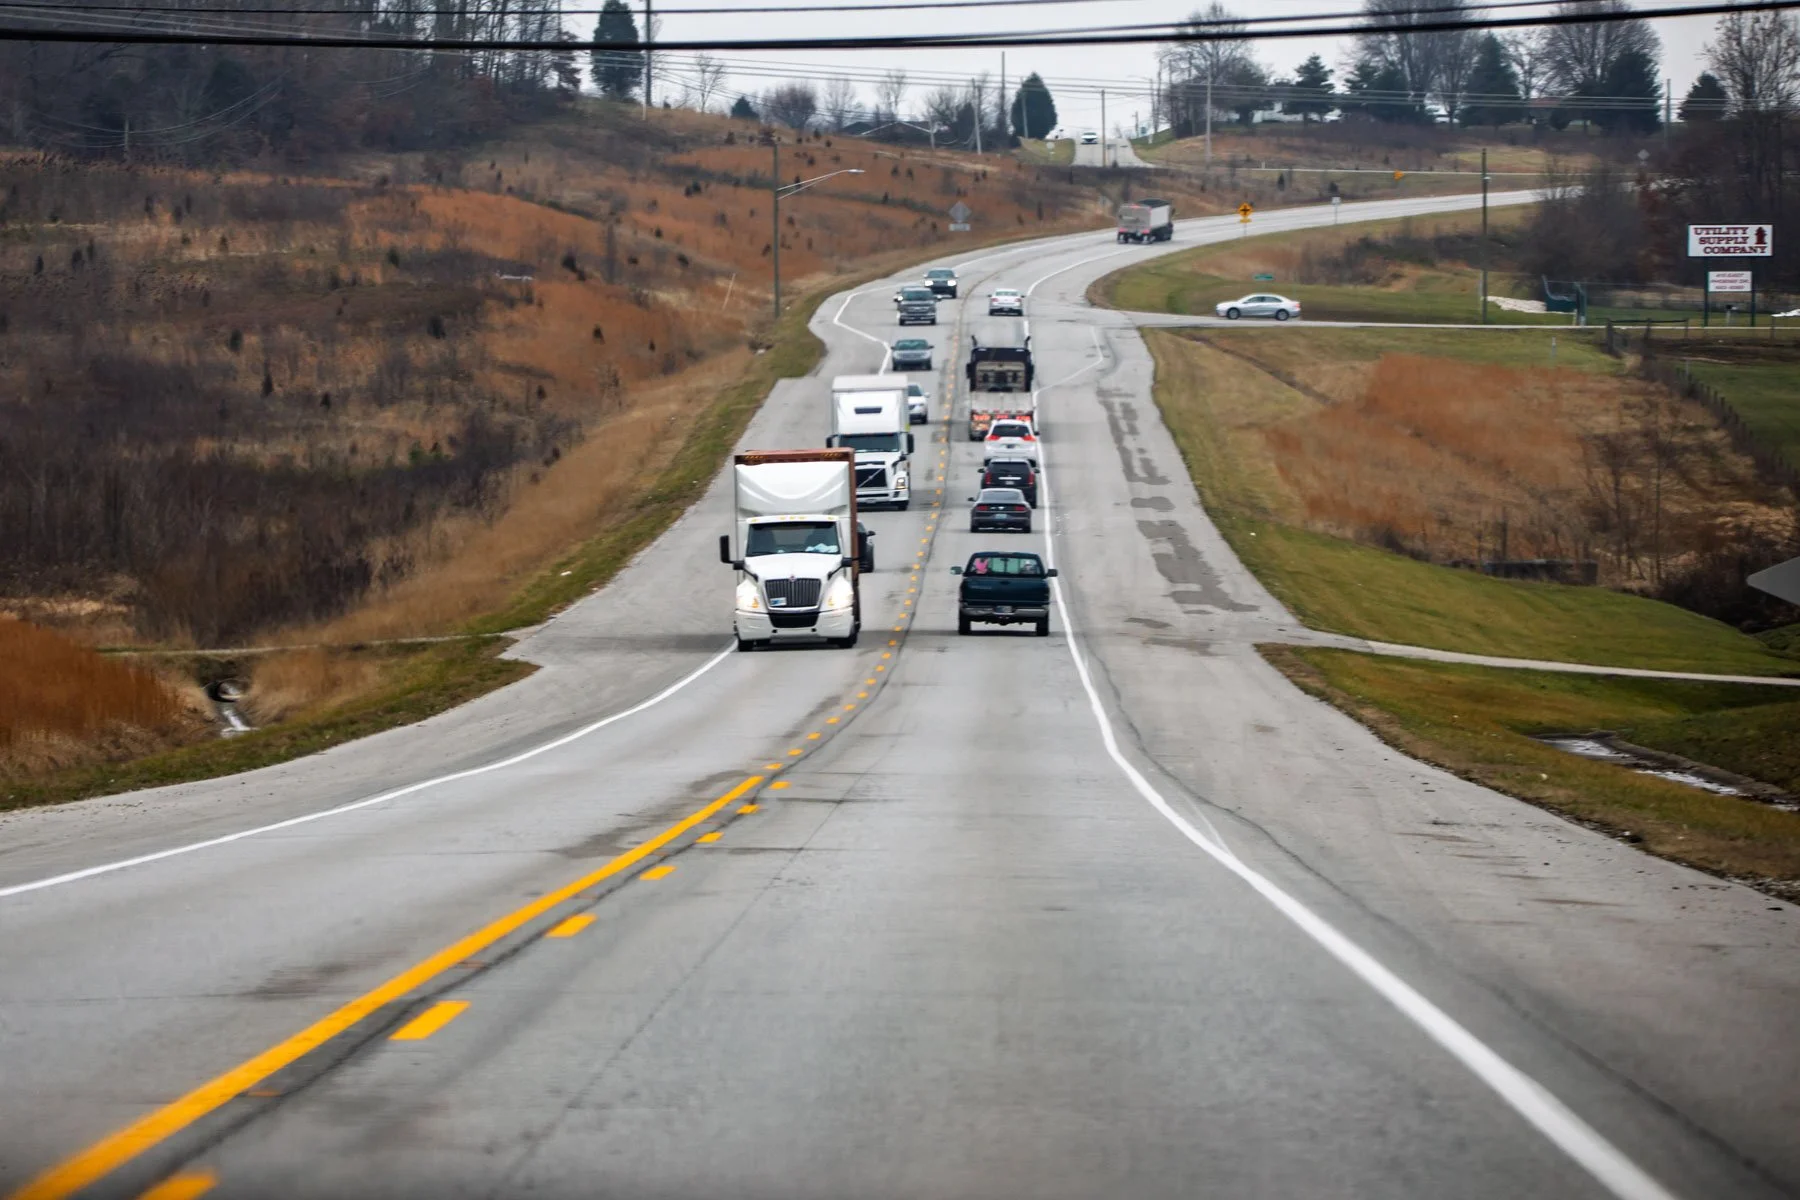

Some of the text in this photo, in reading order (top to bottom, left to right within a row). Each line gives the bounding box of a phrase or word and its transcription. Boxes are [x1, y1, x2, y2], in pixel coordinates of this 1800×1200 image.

[1693, 227, 1749, 235] UTILITY
[1698, 236, 1750, 244] SUPPLY
[1703, 246, 1768, 254] COMPANY
